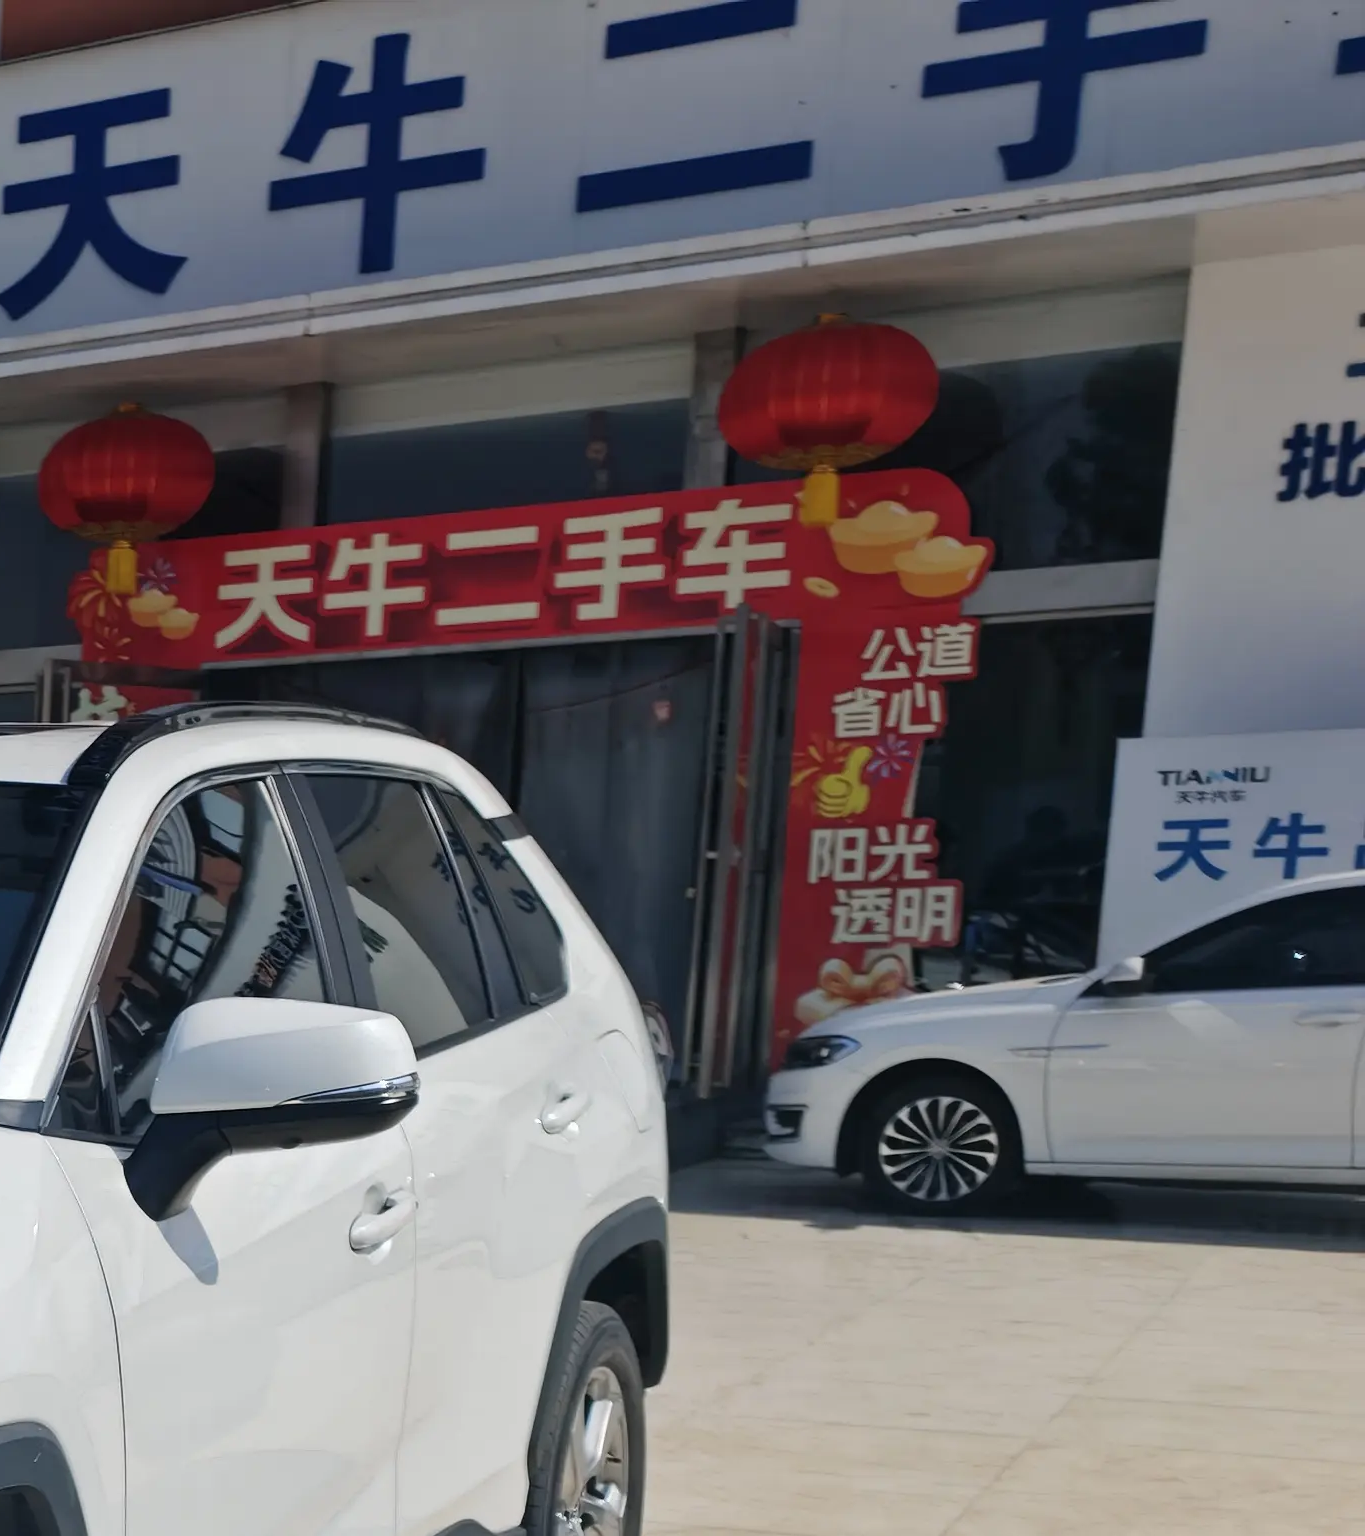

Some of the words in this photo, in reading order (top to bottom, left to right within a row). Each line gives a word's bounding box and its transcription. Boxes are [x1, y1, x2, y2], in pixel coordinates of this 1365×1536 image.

[213, 498, 794, 650] 天牛二手车
[860, 622, 976, 681] 公道
[831, 682, 942, 739] 省心
[807, 824, 933, 884] 阳光
[1154, 812, 1365, 882] 天牛
[830, 885, 957, 944] 透明
